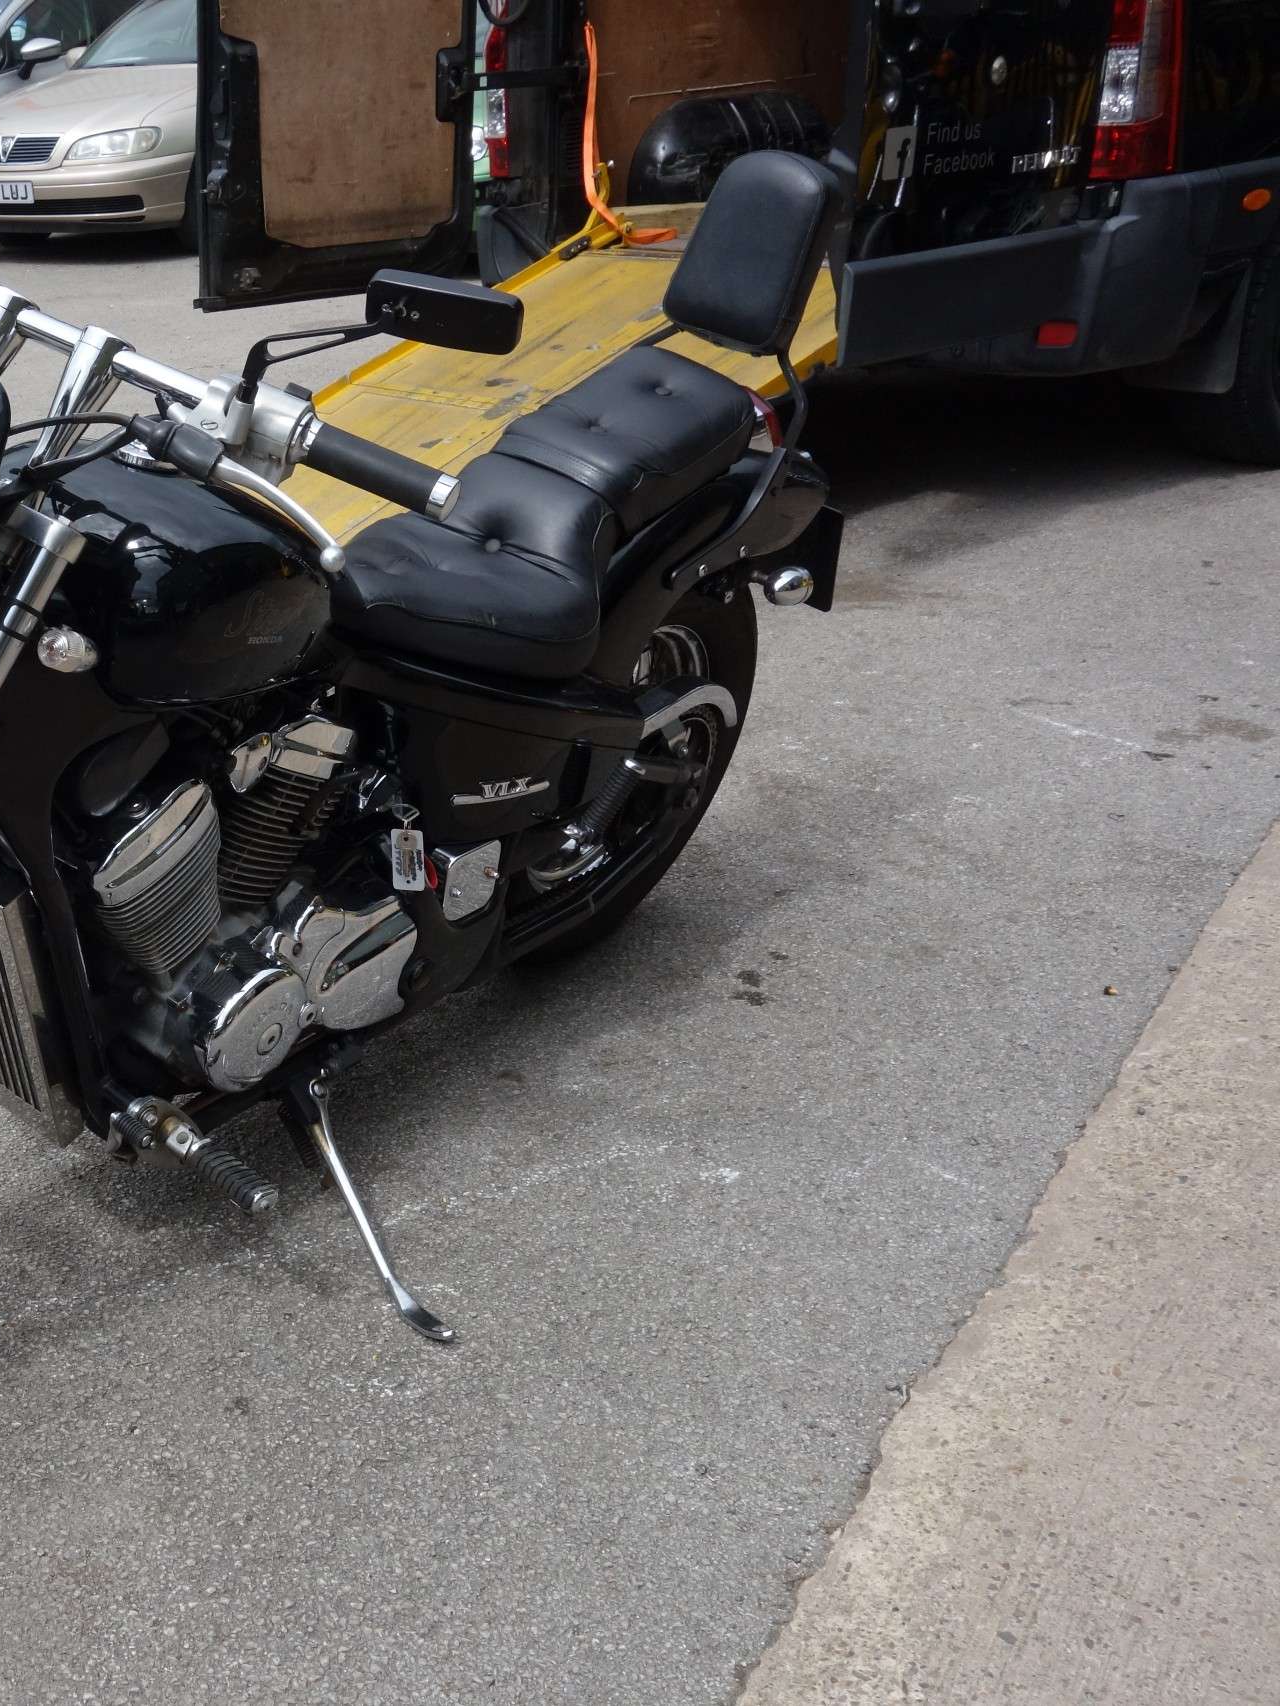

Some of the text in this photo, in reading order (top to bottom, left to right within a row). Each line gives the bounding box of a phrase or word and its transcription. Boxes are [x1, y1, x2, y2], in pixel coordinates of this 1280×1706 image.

[927, 122, 981, 144] Find us
[924, 149, 994, 175] Facebook
[1, 184, 28, 200] LUJ
[479, 776, 531, 798] VLX
